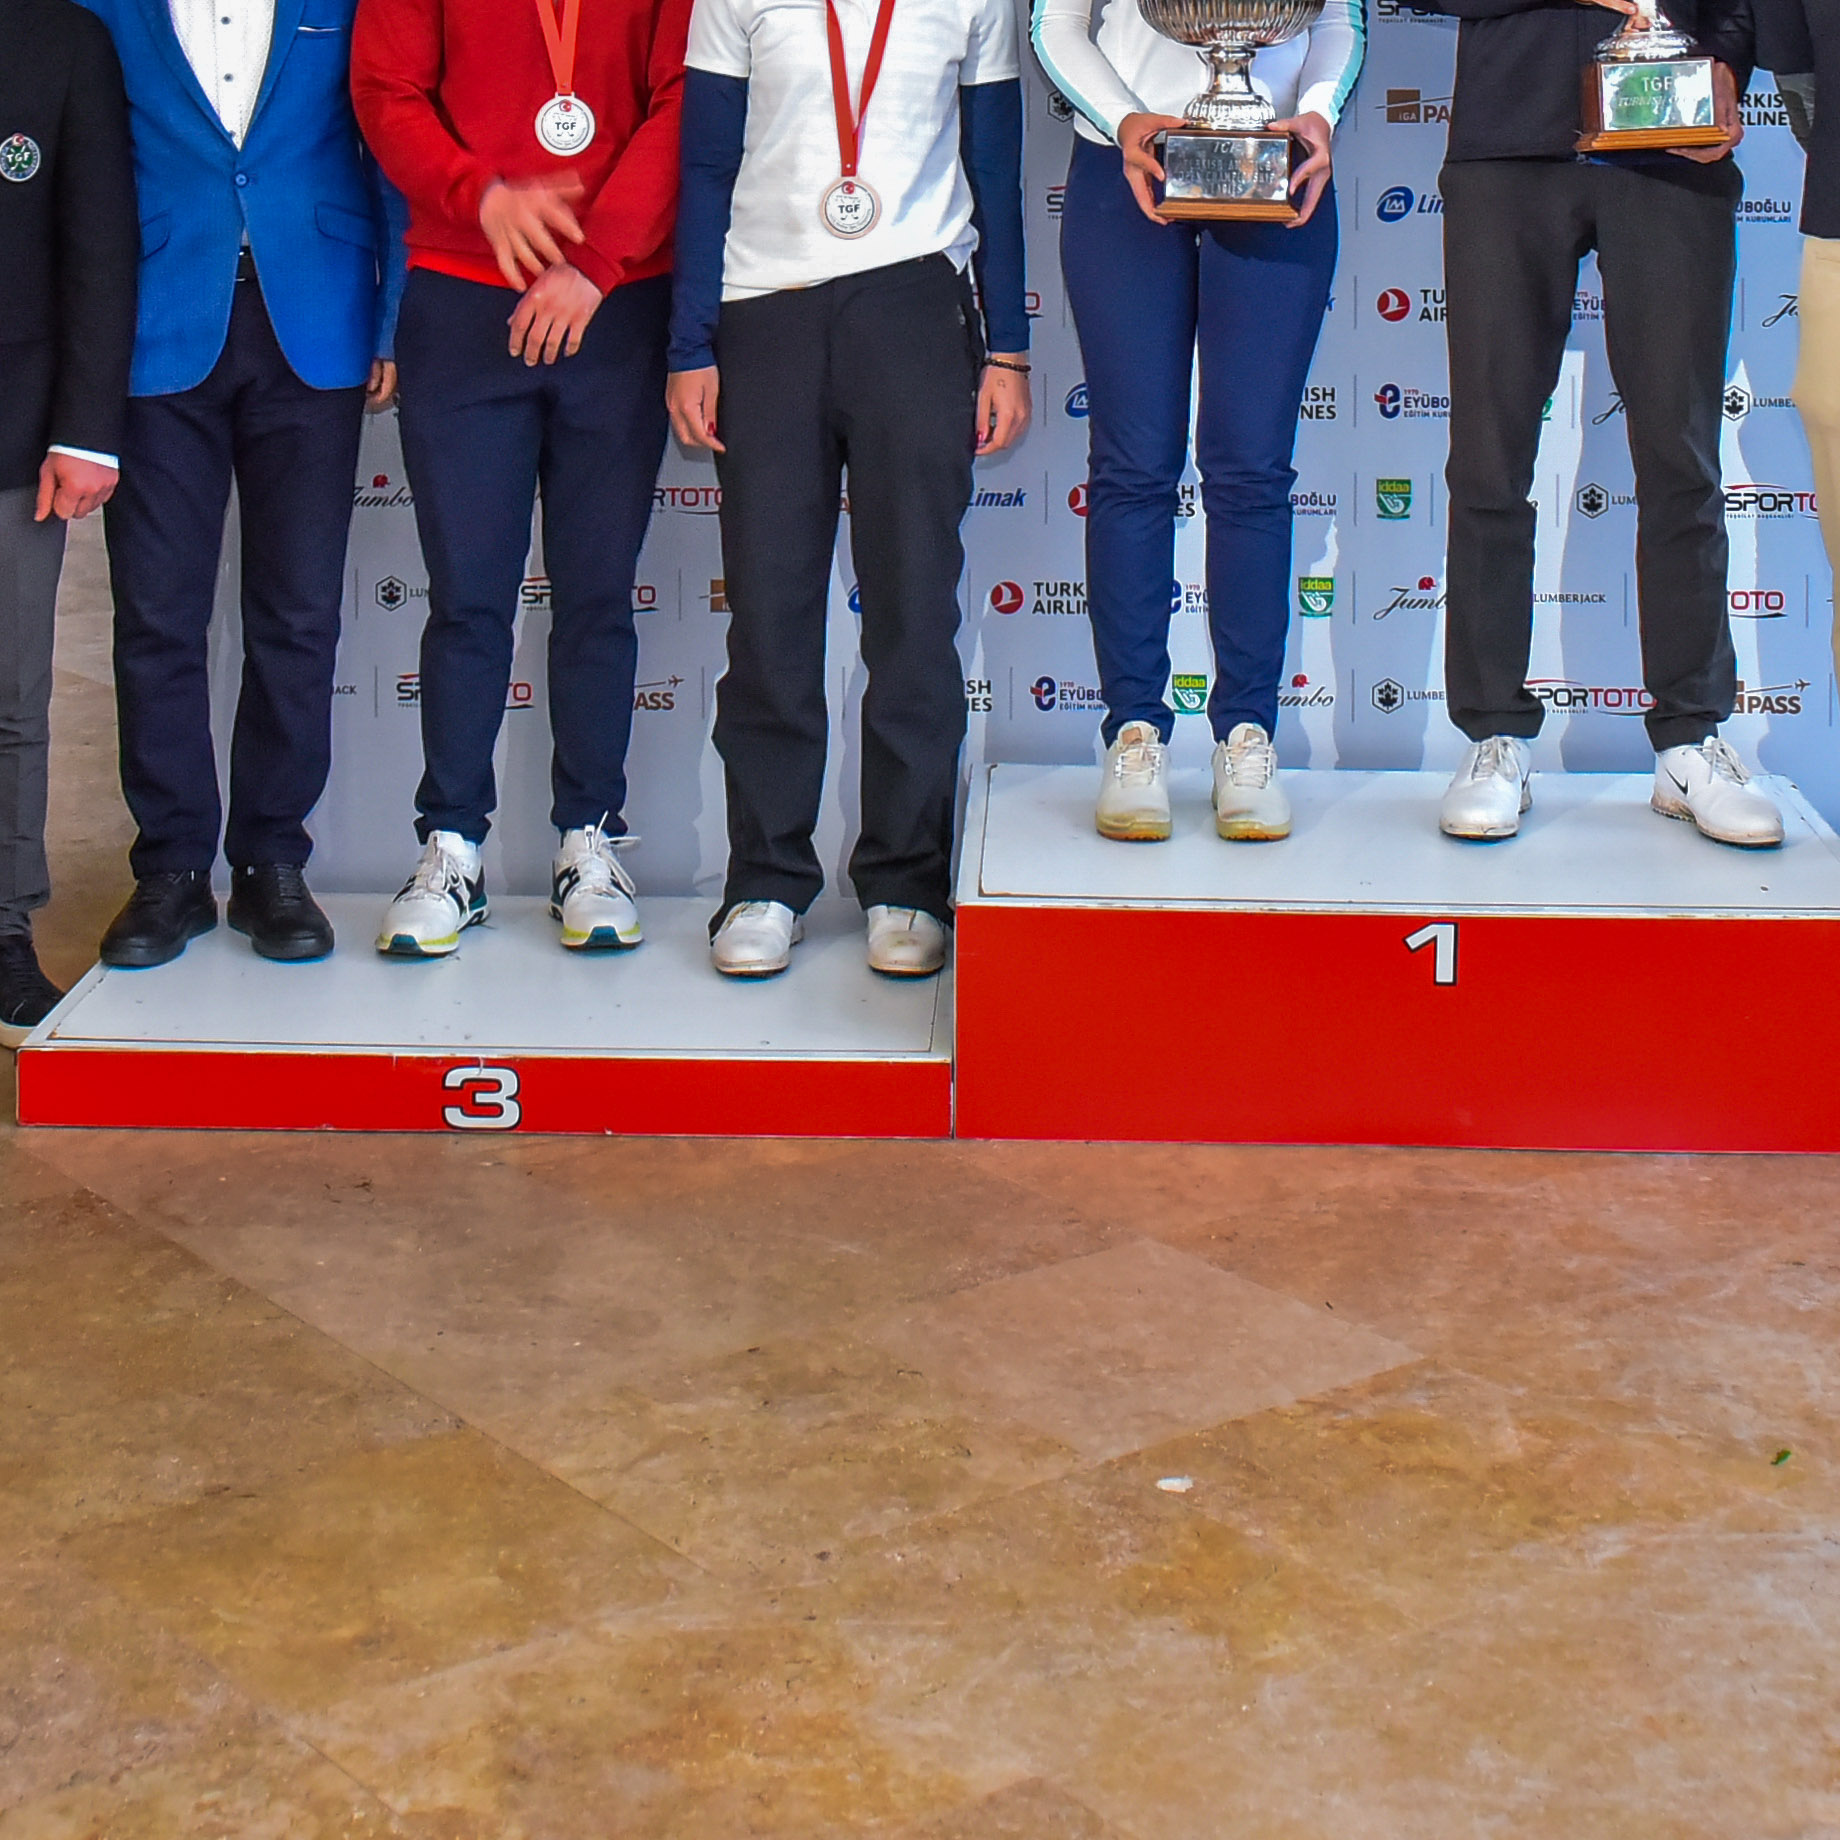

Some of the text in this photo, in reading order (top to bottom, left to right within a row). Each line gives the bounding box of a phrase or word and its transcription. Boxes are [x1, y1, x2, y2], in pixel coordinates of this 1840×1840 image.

[1740, 94, 1783, 109] RKIS
[1423, 105, 1451, 123] PA
[1738, 111, 1789, 126] RLINE
[555, 122, 577, 131] TGF
[838, 203, 860, 214] TGF
[1403, 394, 1450, 409] EYÜBO
[1379, 481, 1410, 493] iddaa
[1291, 491, 1337, 507] BOĞLU
[1033, 581, 1086, 597] TURK
[1299, 579, 1332, 591] iddaa
[1373, 587, 1447, 621] Jumb
[1533, 593, 1606, 604] LUMBERJACK
[1173, 677, 1206, 688] iddaa
[634, 692, 675, 711] ASS
[1406, 690, 1445, 701] LUMBE
[1748, 695, 1802, 715] PASS
[1404, 921, 1459, 987] 1
[441, 1063, 523, 1130] 3
